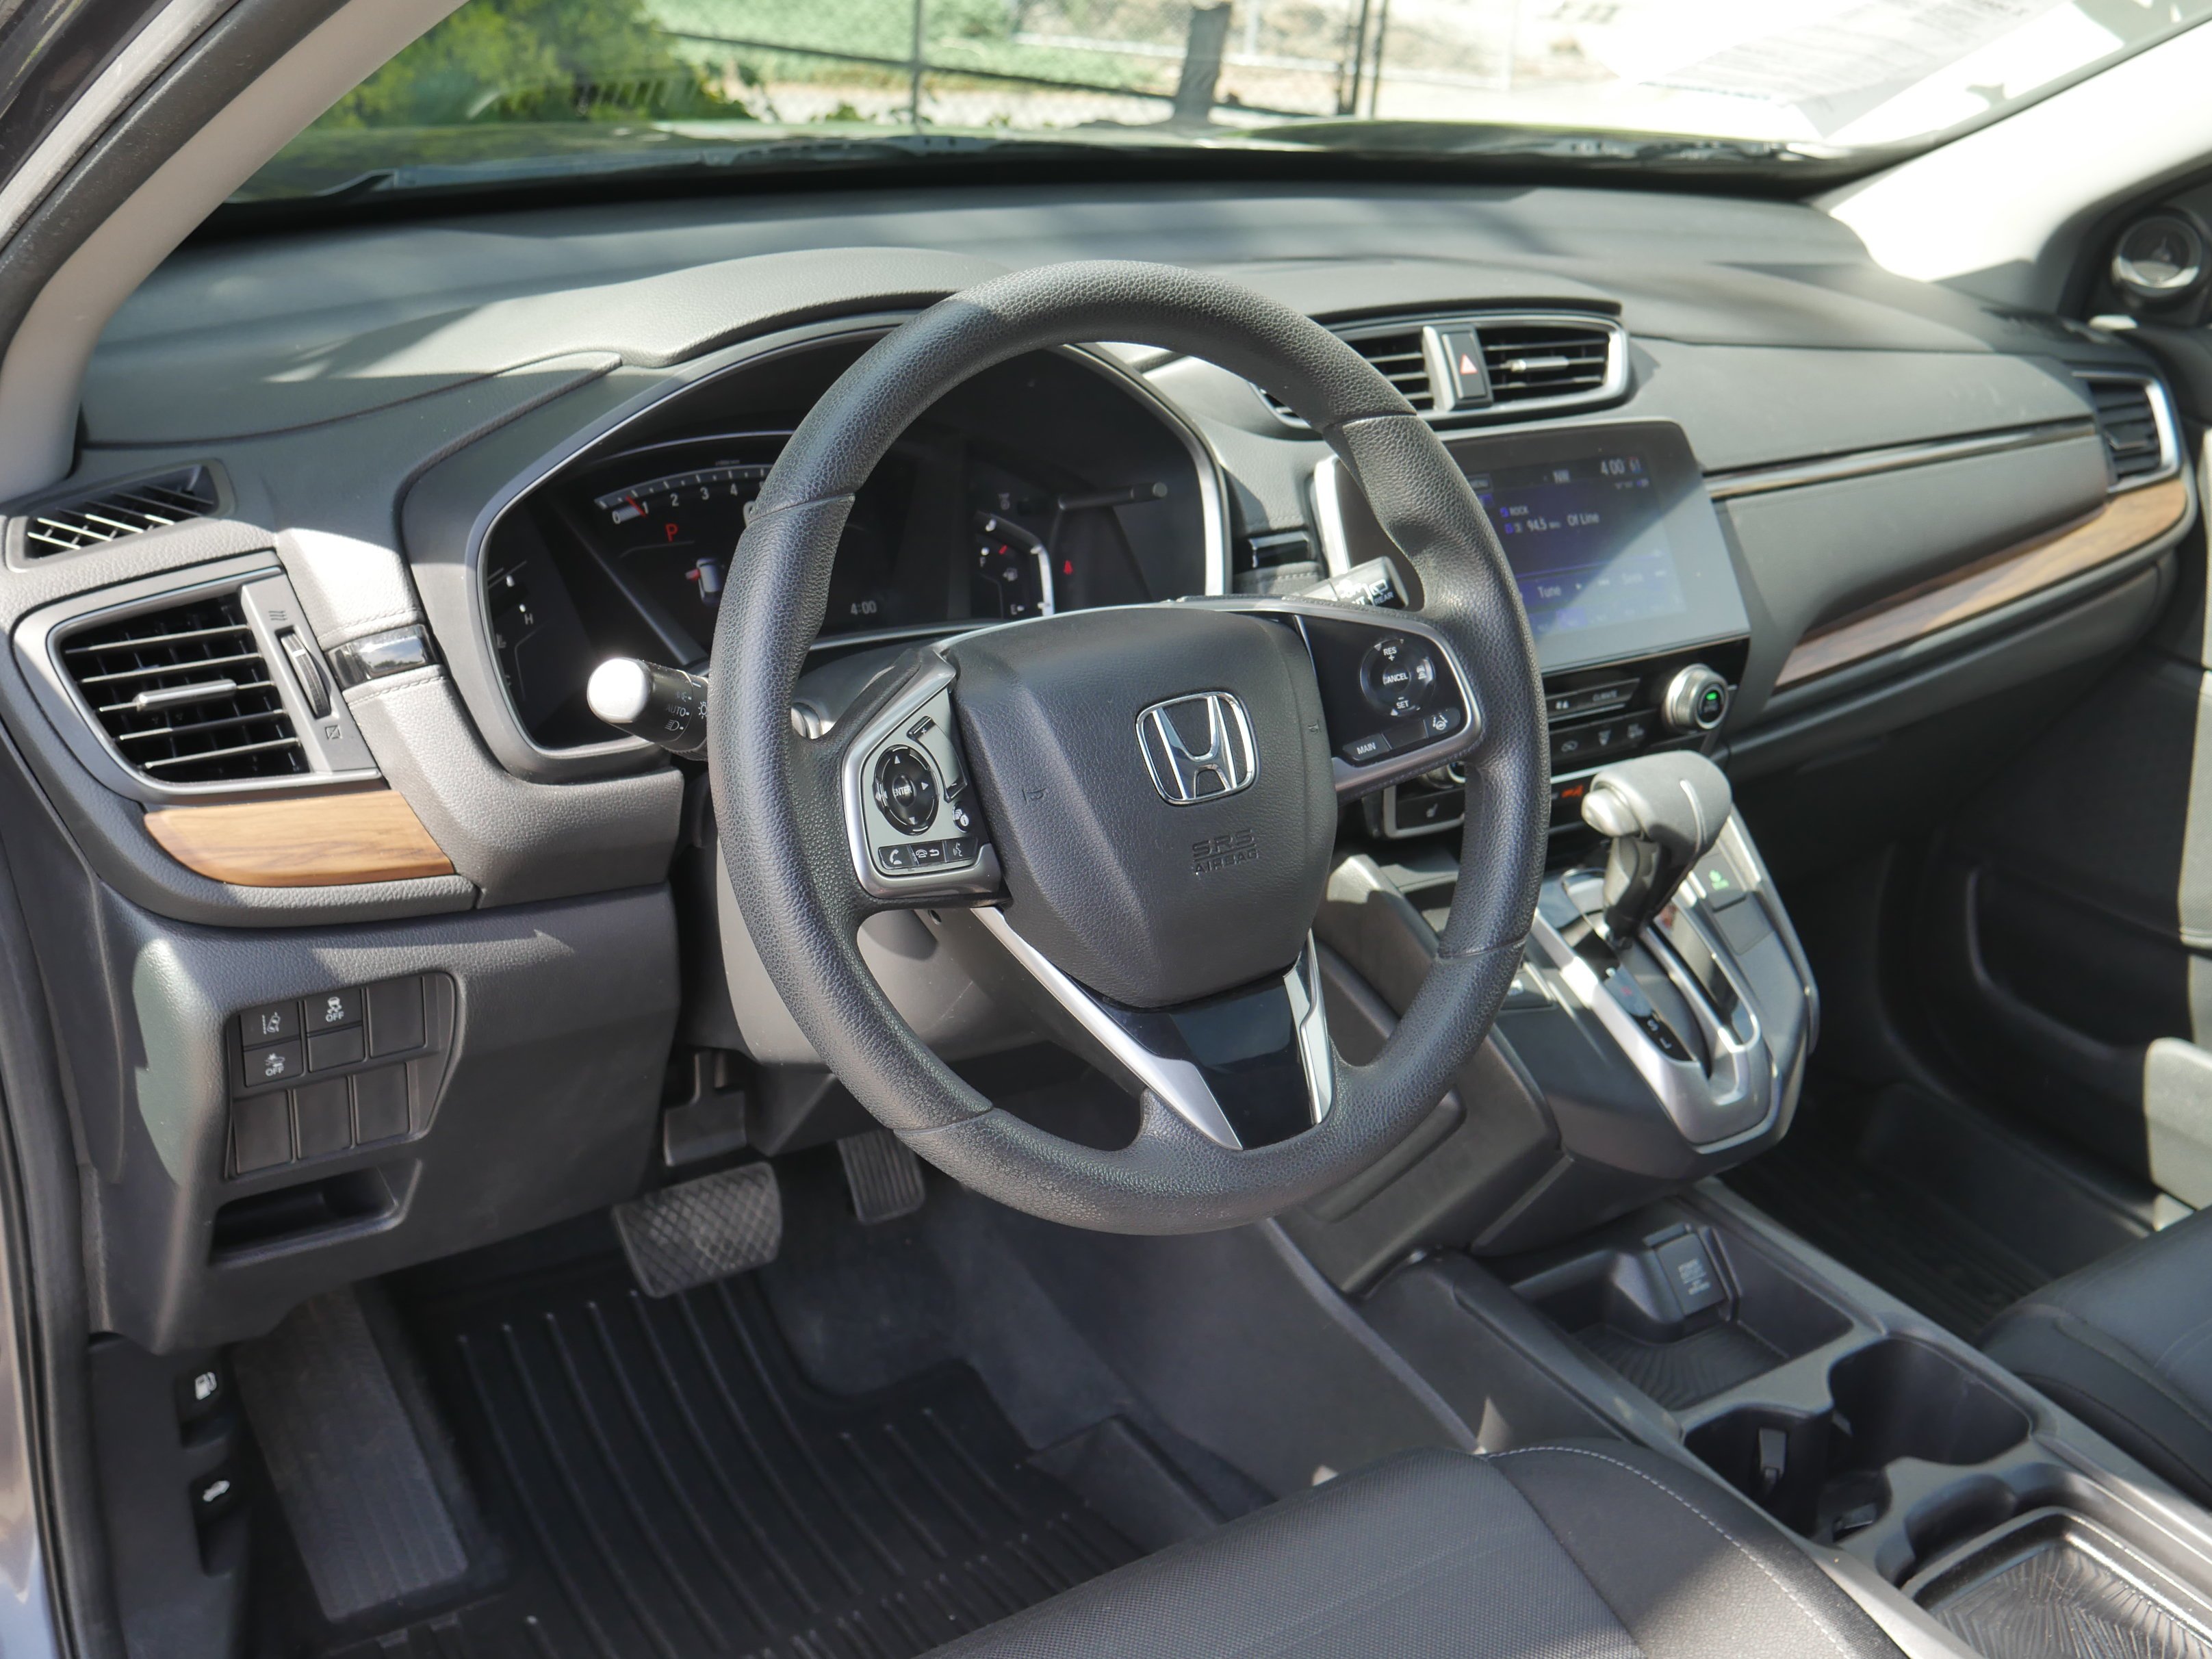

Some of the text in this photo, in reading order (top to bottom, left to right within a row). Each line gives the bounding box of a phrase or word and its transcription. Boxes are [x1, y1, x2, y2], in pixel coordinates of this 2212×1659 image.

[700, 487, 710, 500] 3
[730, 483, 738, 496] 4
[670, 493, 680, 506] 2
[666, 523, 678, 541] P
[1375, 591, 1393, 605] REAR
[851, 601, 877, 615] 4:00
[525, 613, 533, 625] H
[1383, 647, 1396, 655] RES
[1382, 673, 1408, 684] CANCEL
[666, 704, 686, 717] AUTO
[1396, 700, 1409, 709] SET
[1356, 742, 1376, 755] MAIN
[893, 785, 912, 797] ENTER
[1192, 829, 1255, 858] SRS
[1194, 849, 1259, 874] AIRBAG
[326, 1011, 344, 1023] OFF
[266, 1066, 284, 1077] OFF
